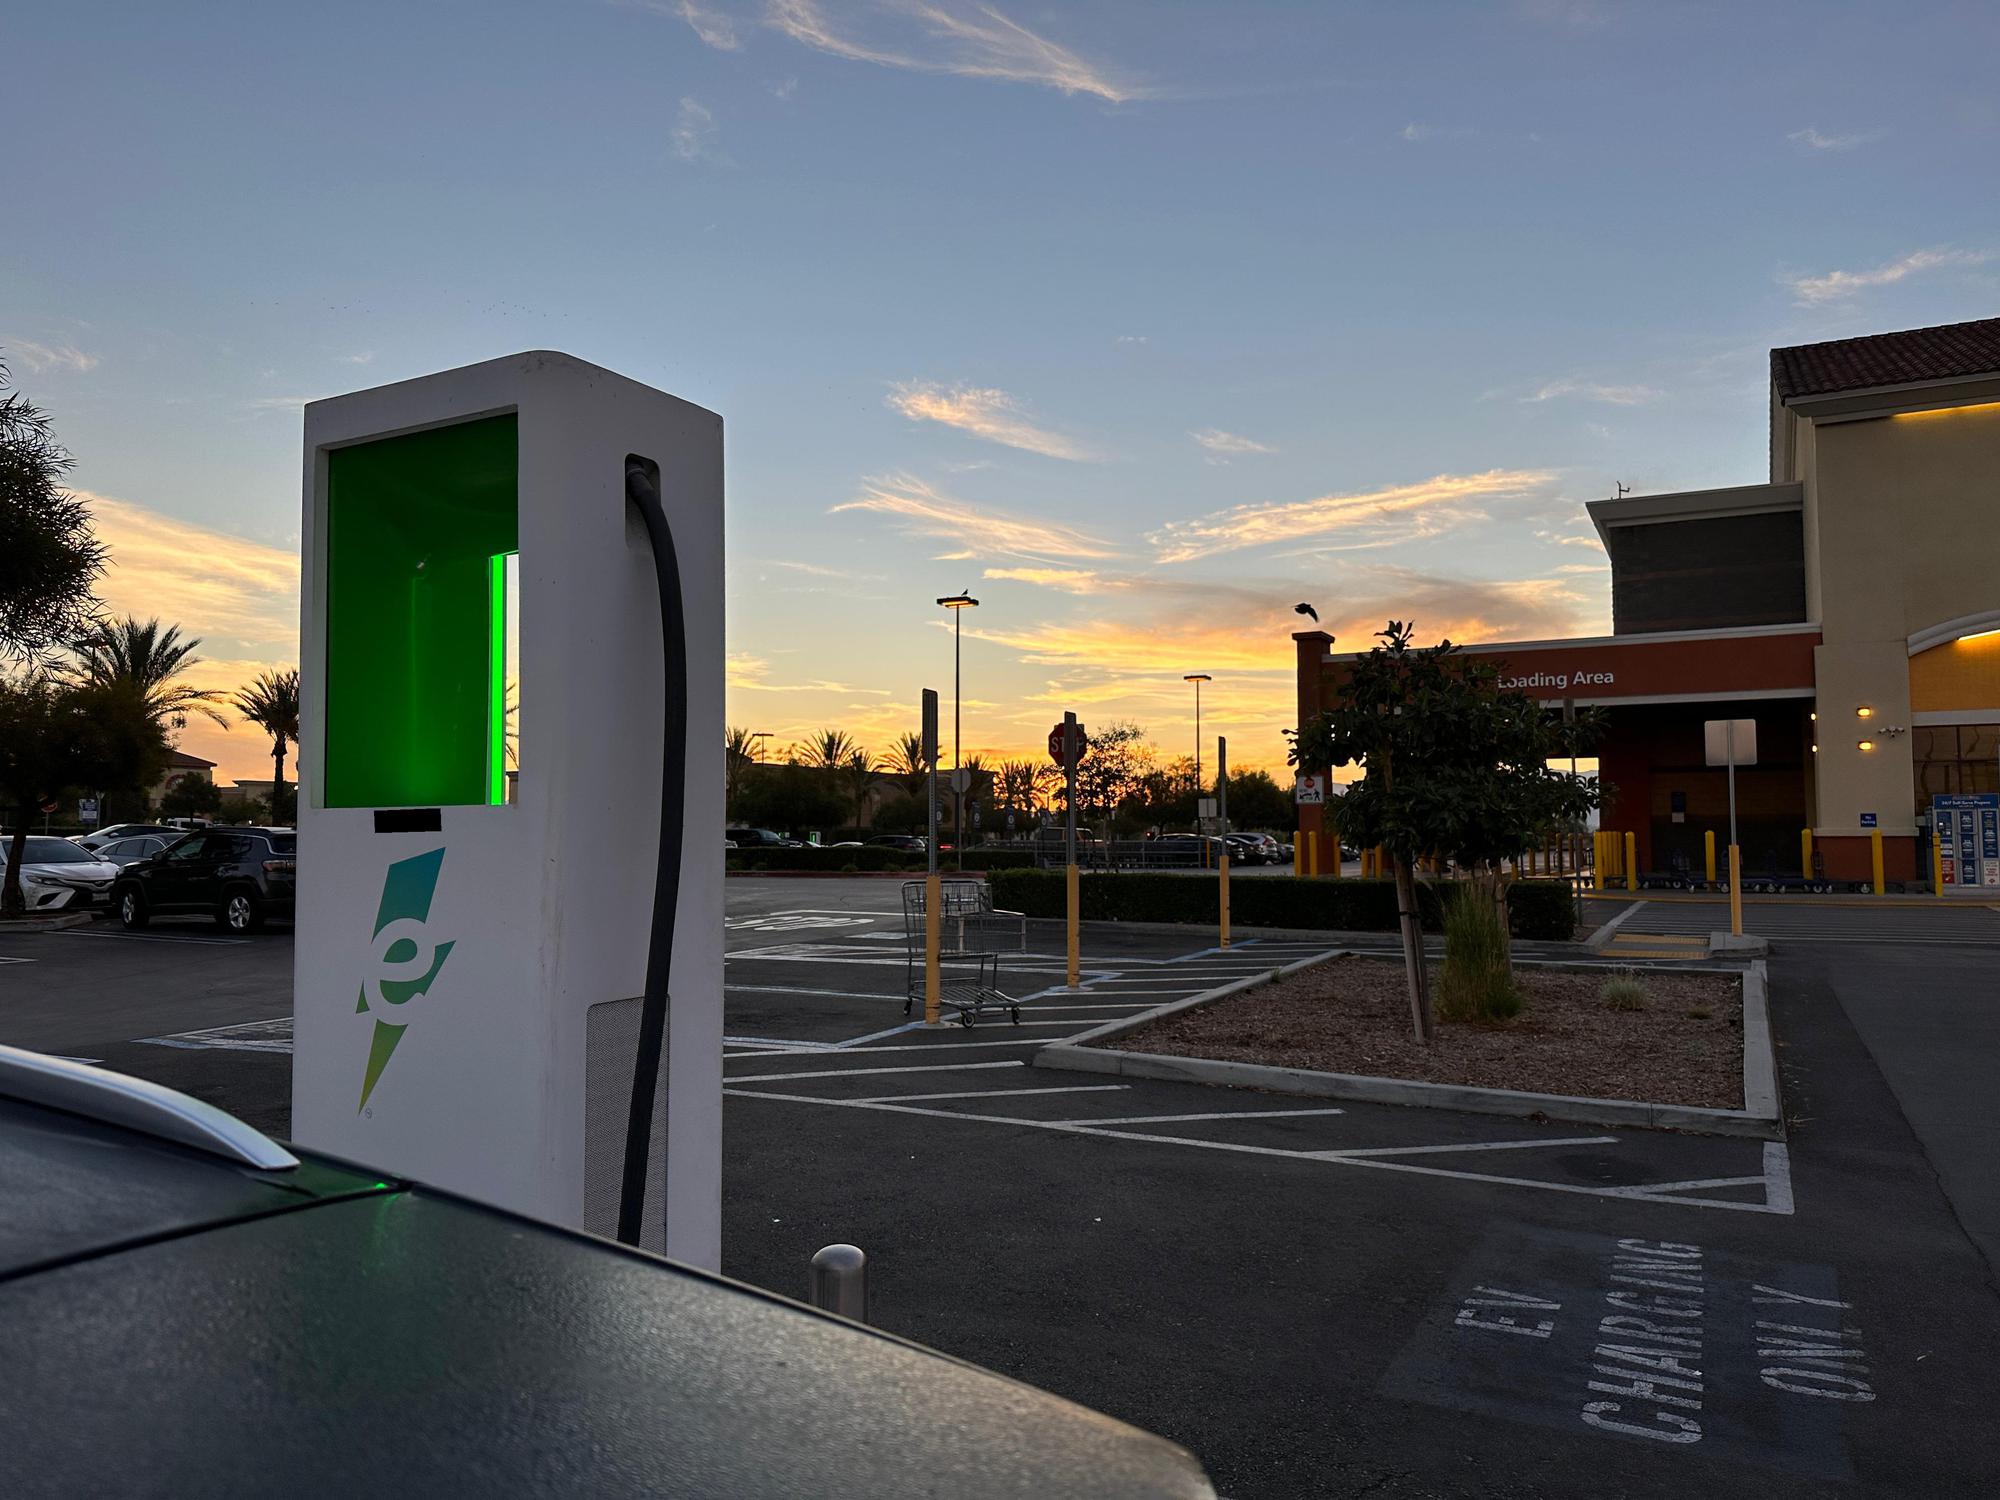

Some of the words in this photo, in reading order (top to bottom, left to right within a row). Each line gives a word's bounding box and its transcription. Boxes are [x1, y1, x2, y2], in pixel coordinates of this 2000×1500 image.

[1498, 672, 1567, 689] Loading
[1573, 671, 1614, 685] Area
[1051, 736, 1085, 752] STP
[1454, 1285, 1561, 1338] EV
[1580, 1238, 1704, 1444] CHARGING
[1751, 1283, 1877, 1402] ONLY
